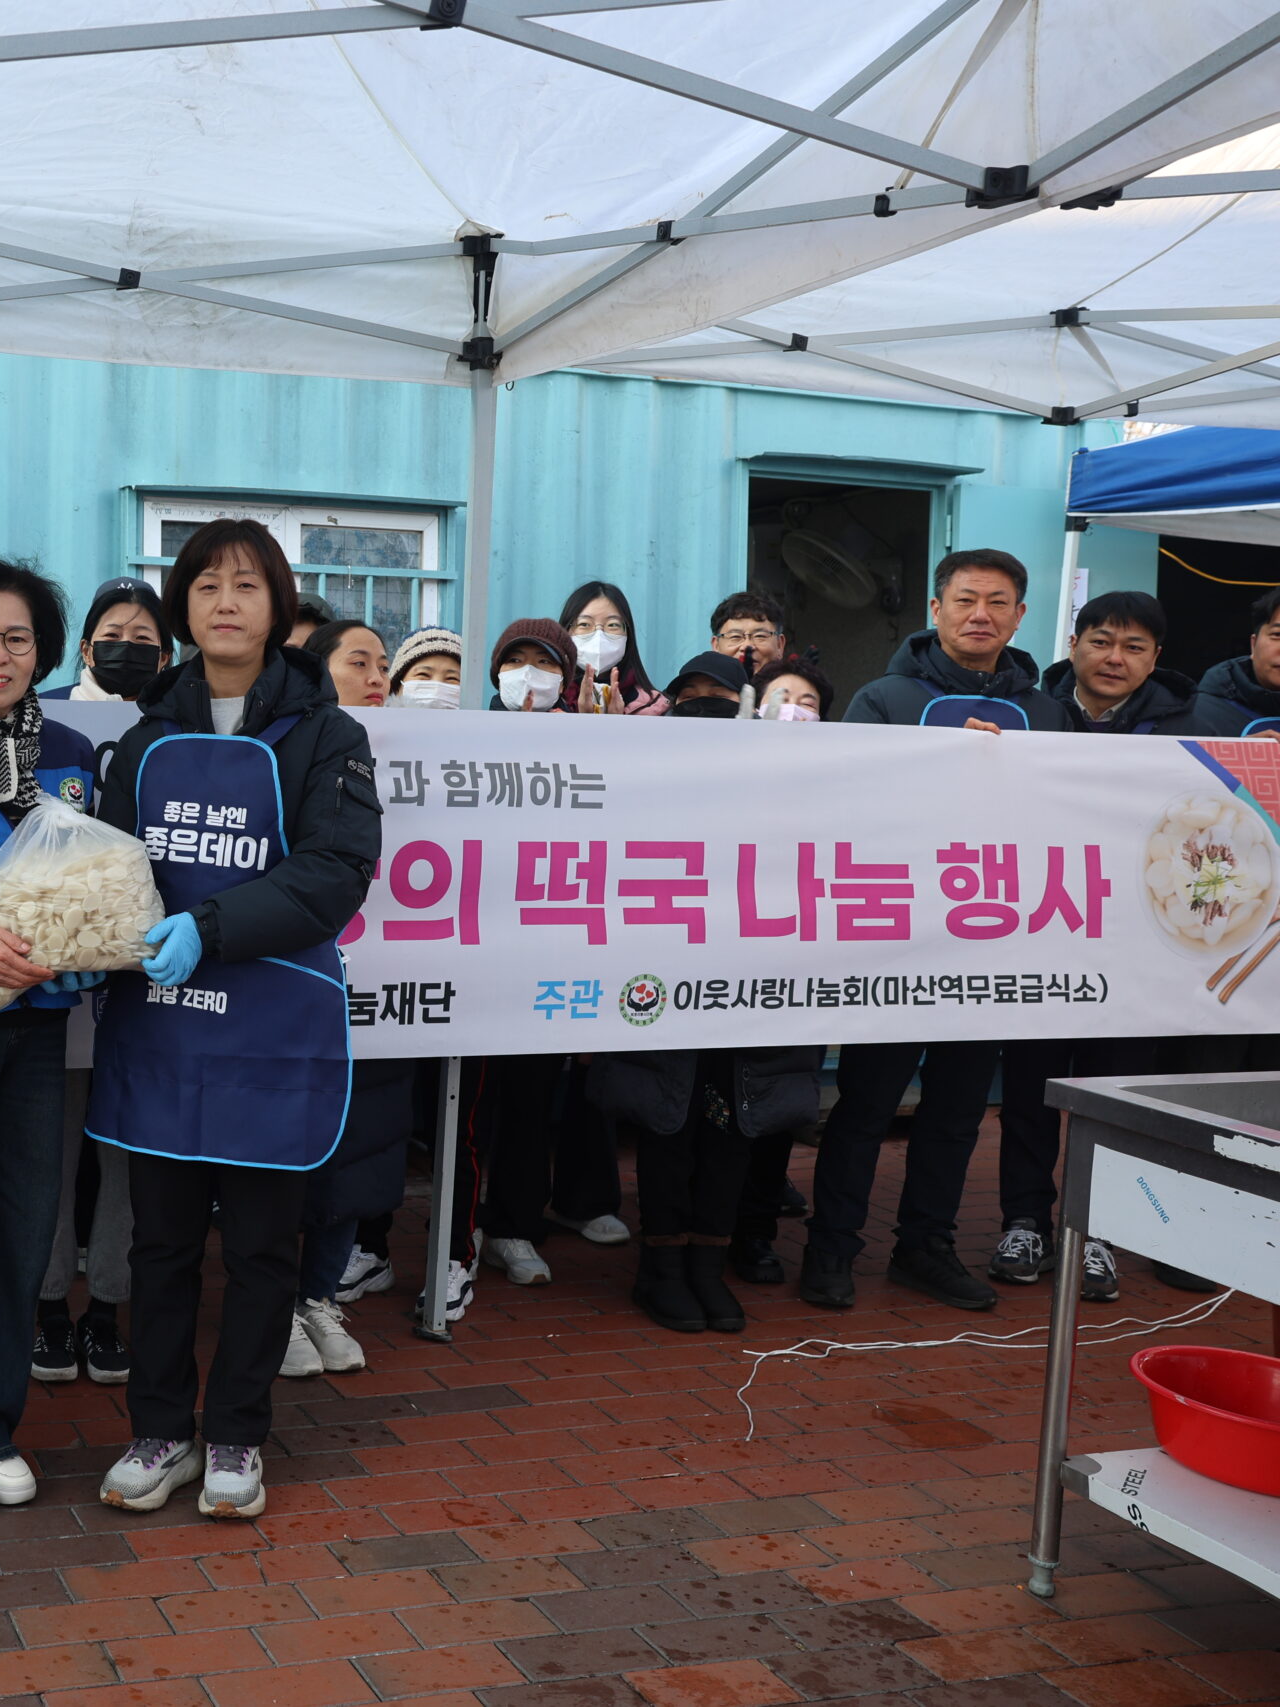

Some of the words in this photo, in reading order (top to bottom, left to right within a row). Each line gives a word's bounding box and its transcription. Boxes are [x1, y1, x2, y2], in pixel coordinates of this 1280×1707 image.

[440, 760, 607, 809] 함께하는
[163, 800, 201, 824] 좋은
[205, 804, 248, 830] 날엔
[144, 826, 269, 871] 좋은데이
[514, 840, 709, 945] 떡국
[736, 841, 915, 942] 나눔
[936, 842, 1112, 940] 행사
[146, 981, 179, 1005] 과당
[182, 987, 228, 1015] ZERO
[533, 979, 605, 1021] 주관
[673, 973, 1109, 1013] 이웃사랑나눔회(마산역무료급식소)
[1136, 1176, 1170, 1224] DONGSUNG
[1120, 1468, 1147, 1496] STEEL
